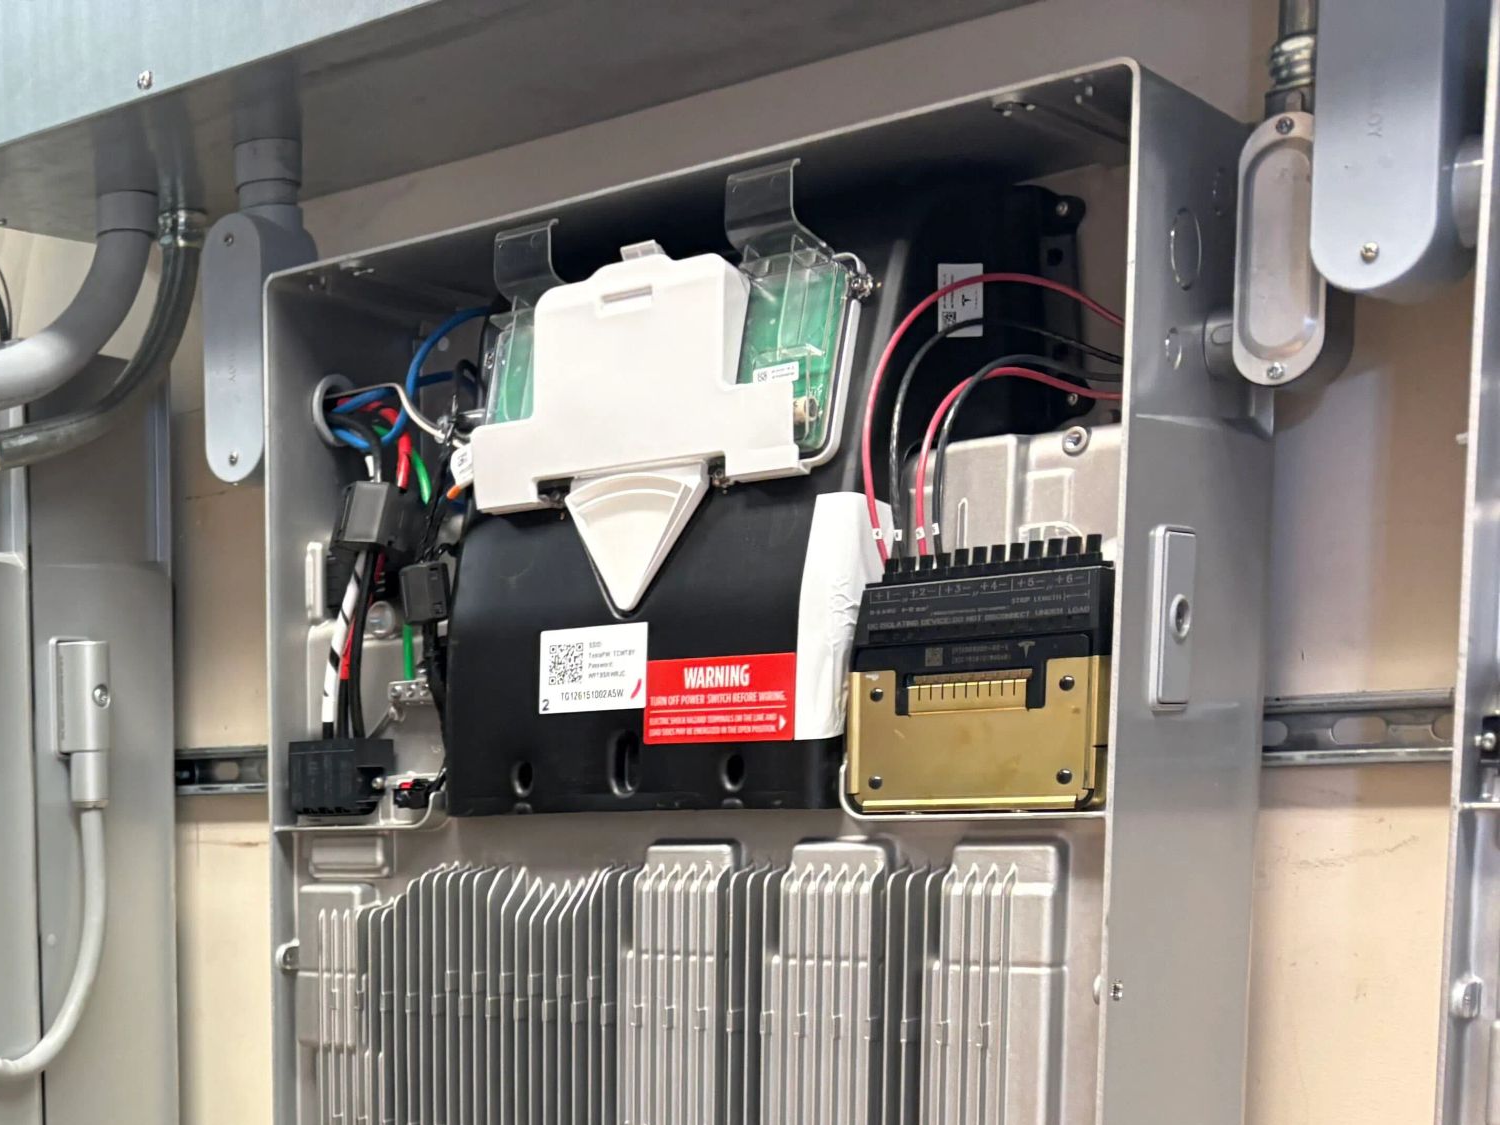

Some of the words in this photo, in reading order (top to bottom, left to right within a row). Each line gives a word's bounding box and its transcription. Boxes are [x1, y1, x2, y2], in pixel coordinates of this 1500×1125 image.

[1067, 605, 1091, 614] LOAD
[684, 664, 750, 689] WARNING
[542, 699, 550, 711] 2
[650, 696, 667, 706] TURN
[668, 695, 679, 705] OFF
[681, 694, 705, 704] POWER
[707, 693, 731, 704] SWITCH
[733, 692, 757, 702] BEFORE
